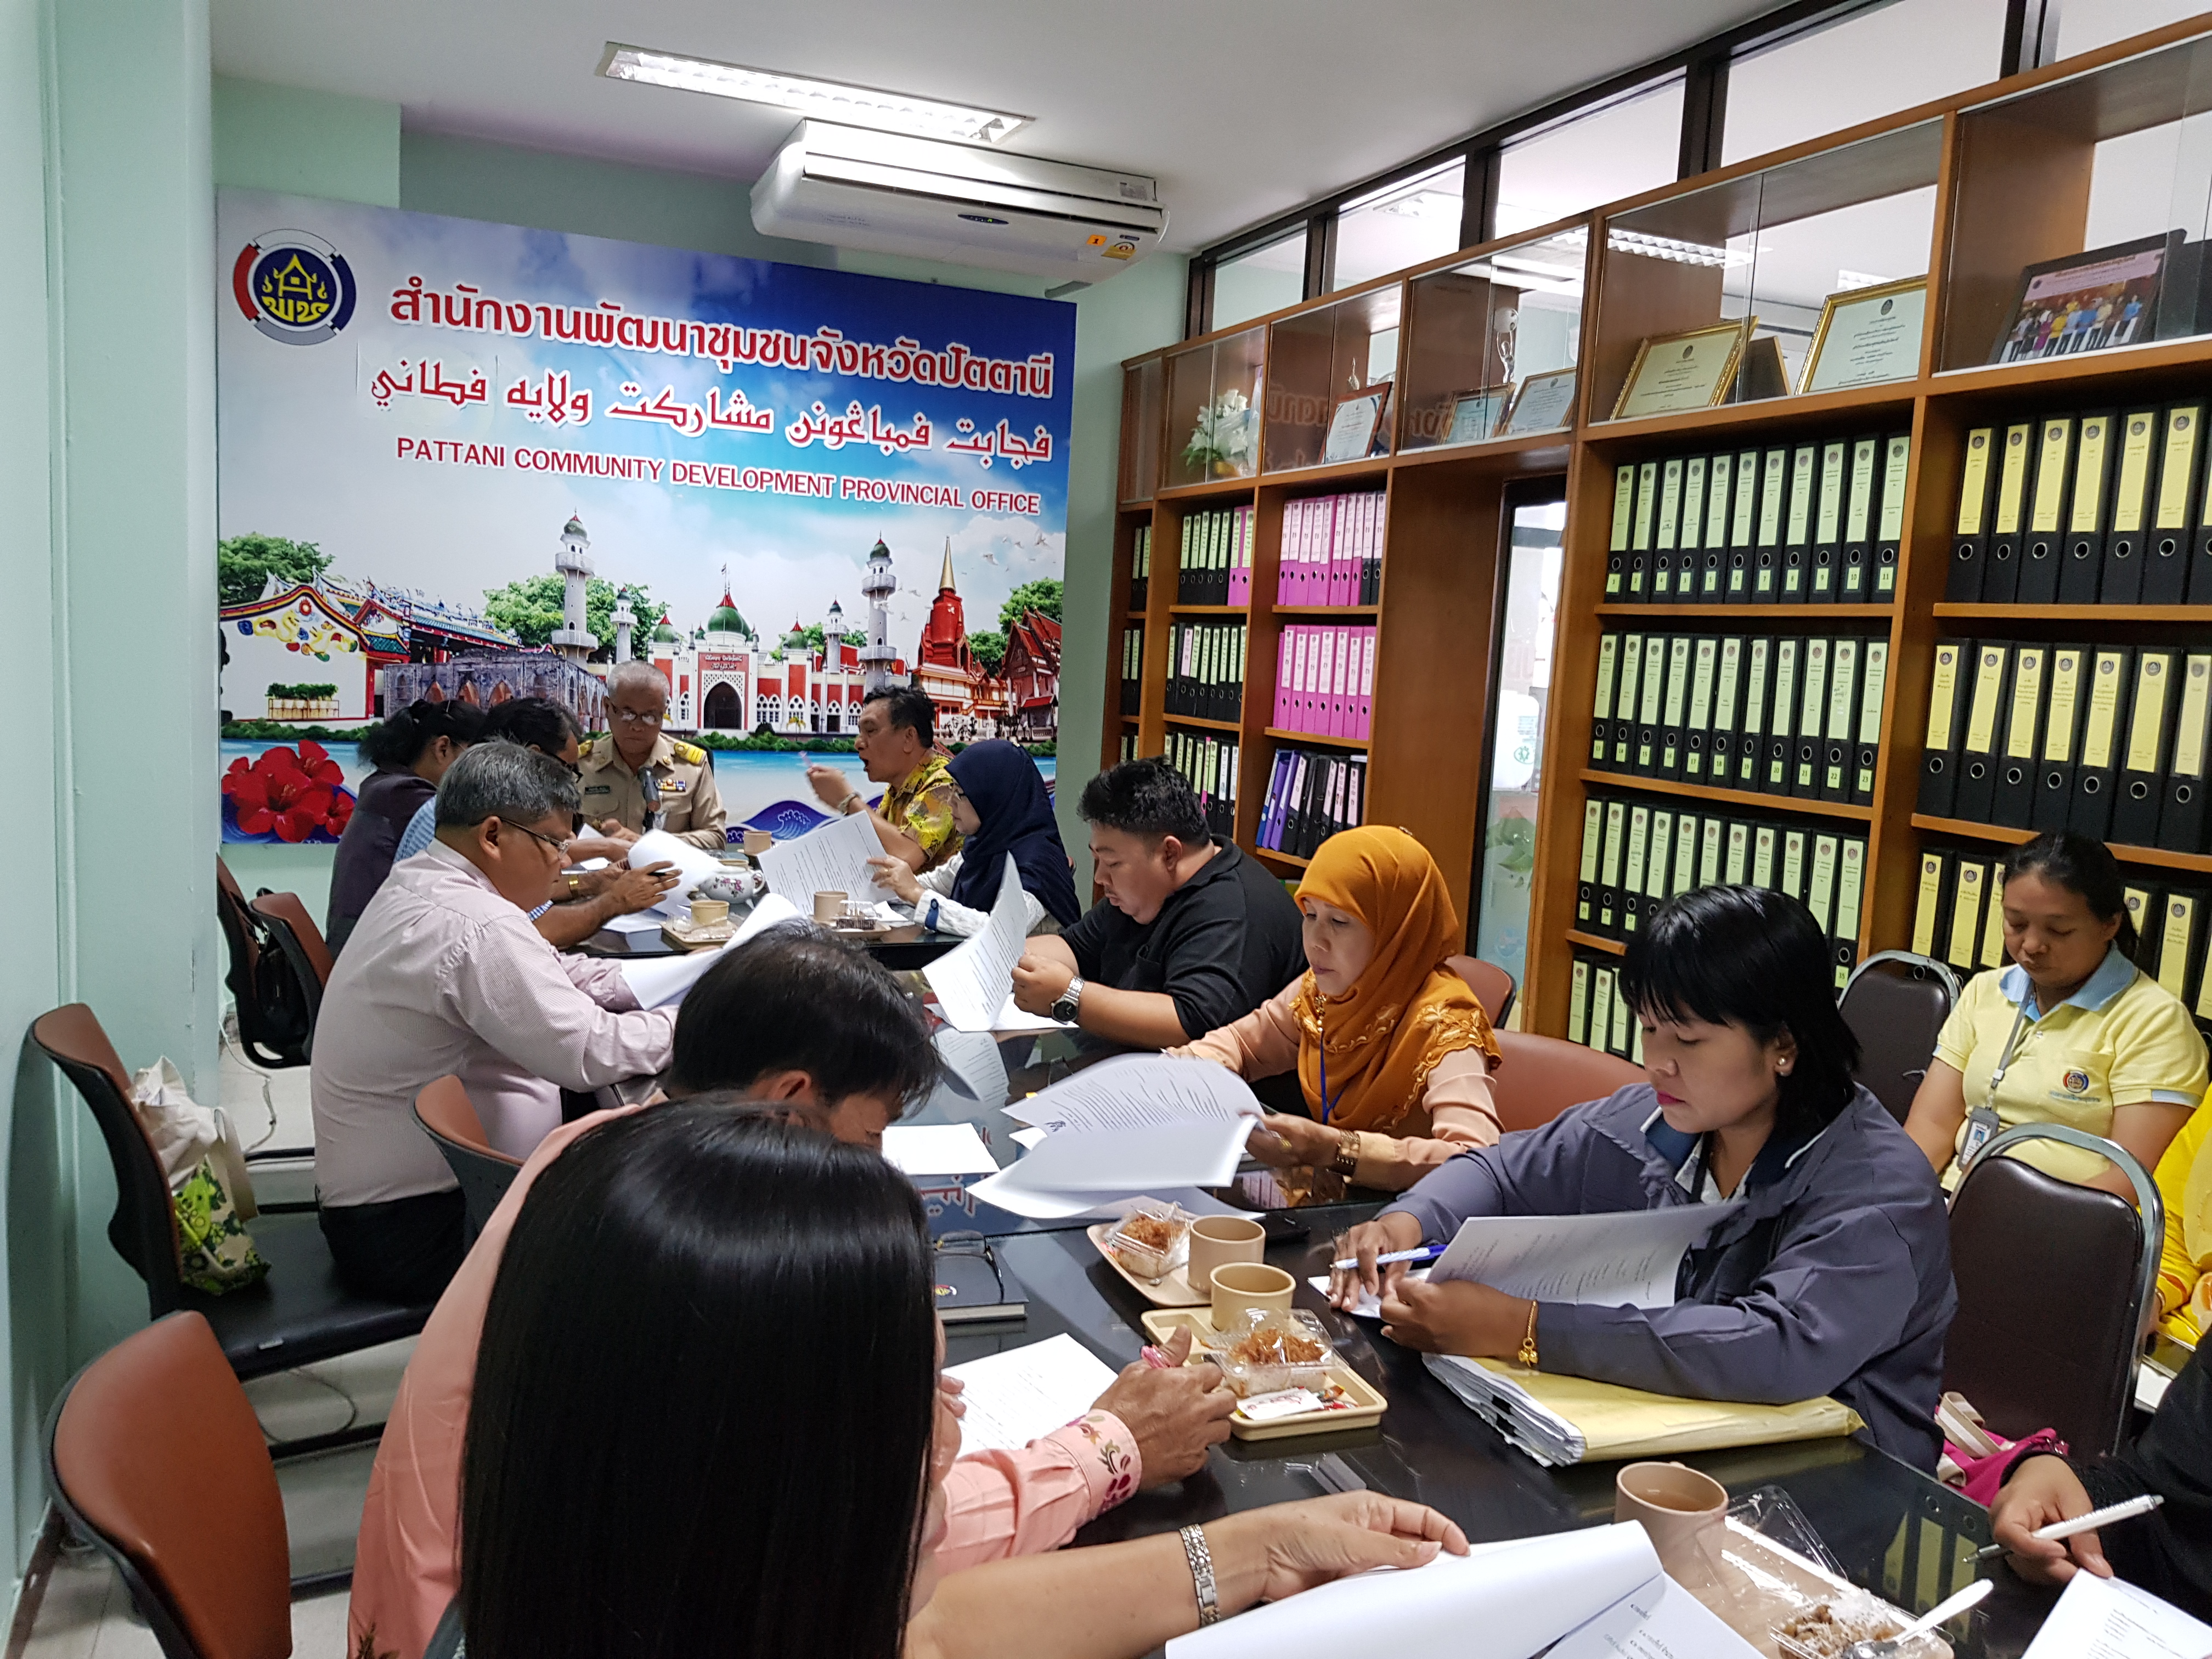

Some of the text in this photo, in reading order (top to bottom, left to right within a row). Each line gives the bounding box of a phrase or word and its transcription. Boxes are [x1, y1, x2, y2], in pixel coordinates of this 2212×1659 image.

[391, 276, 1051, 395] สำนักงานพัฒนาชุมชนจังหวัดปัตตานี
[398, 437, 1040, 514] PATTANI COMMUNITY DEVELOPMENT PROVINCIAL OFFICE
